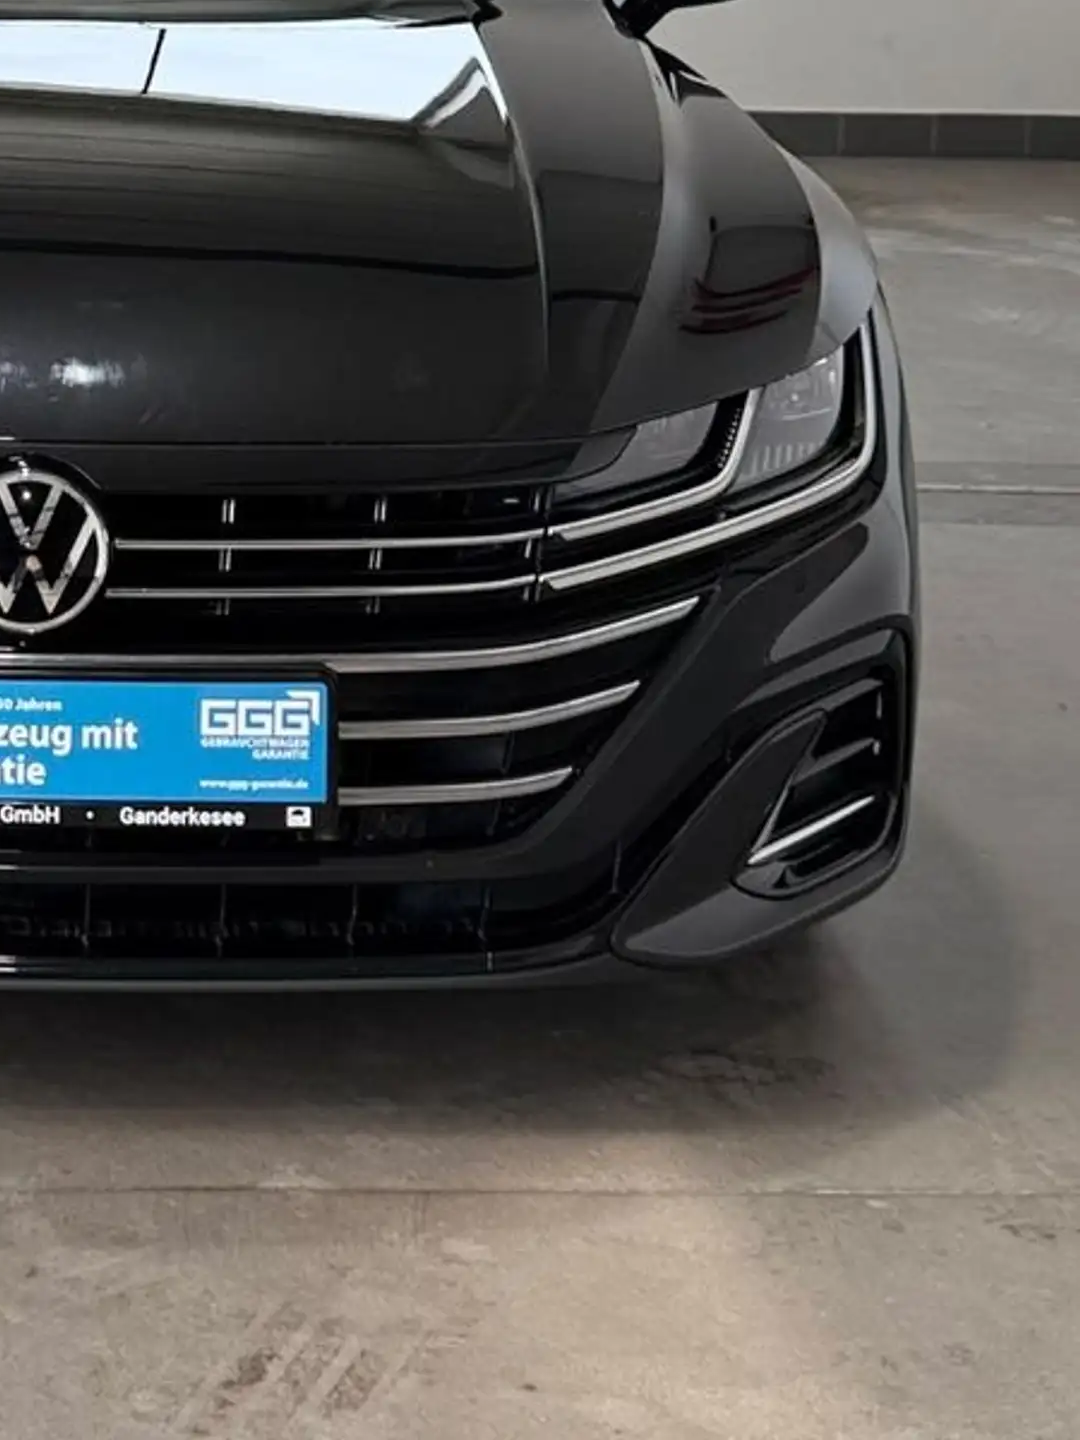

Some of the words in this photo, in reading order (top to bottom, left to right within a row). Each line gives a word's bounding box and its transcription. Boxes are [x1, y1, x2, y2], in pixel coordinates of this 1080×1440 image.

[81, 717, 138, 750] mit
[200, 699, 310, 736] GGG
[0, 806, 61, 824] GmbH
[120, 806, 246, 827] Ganderkesee
